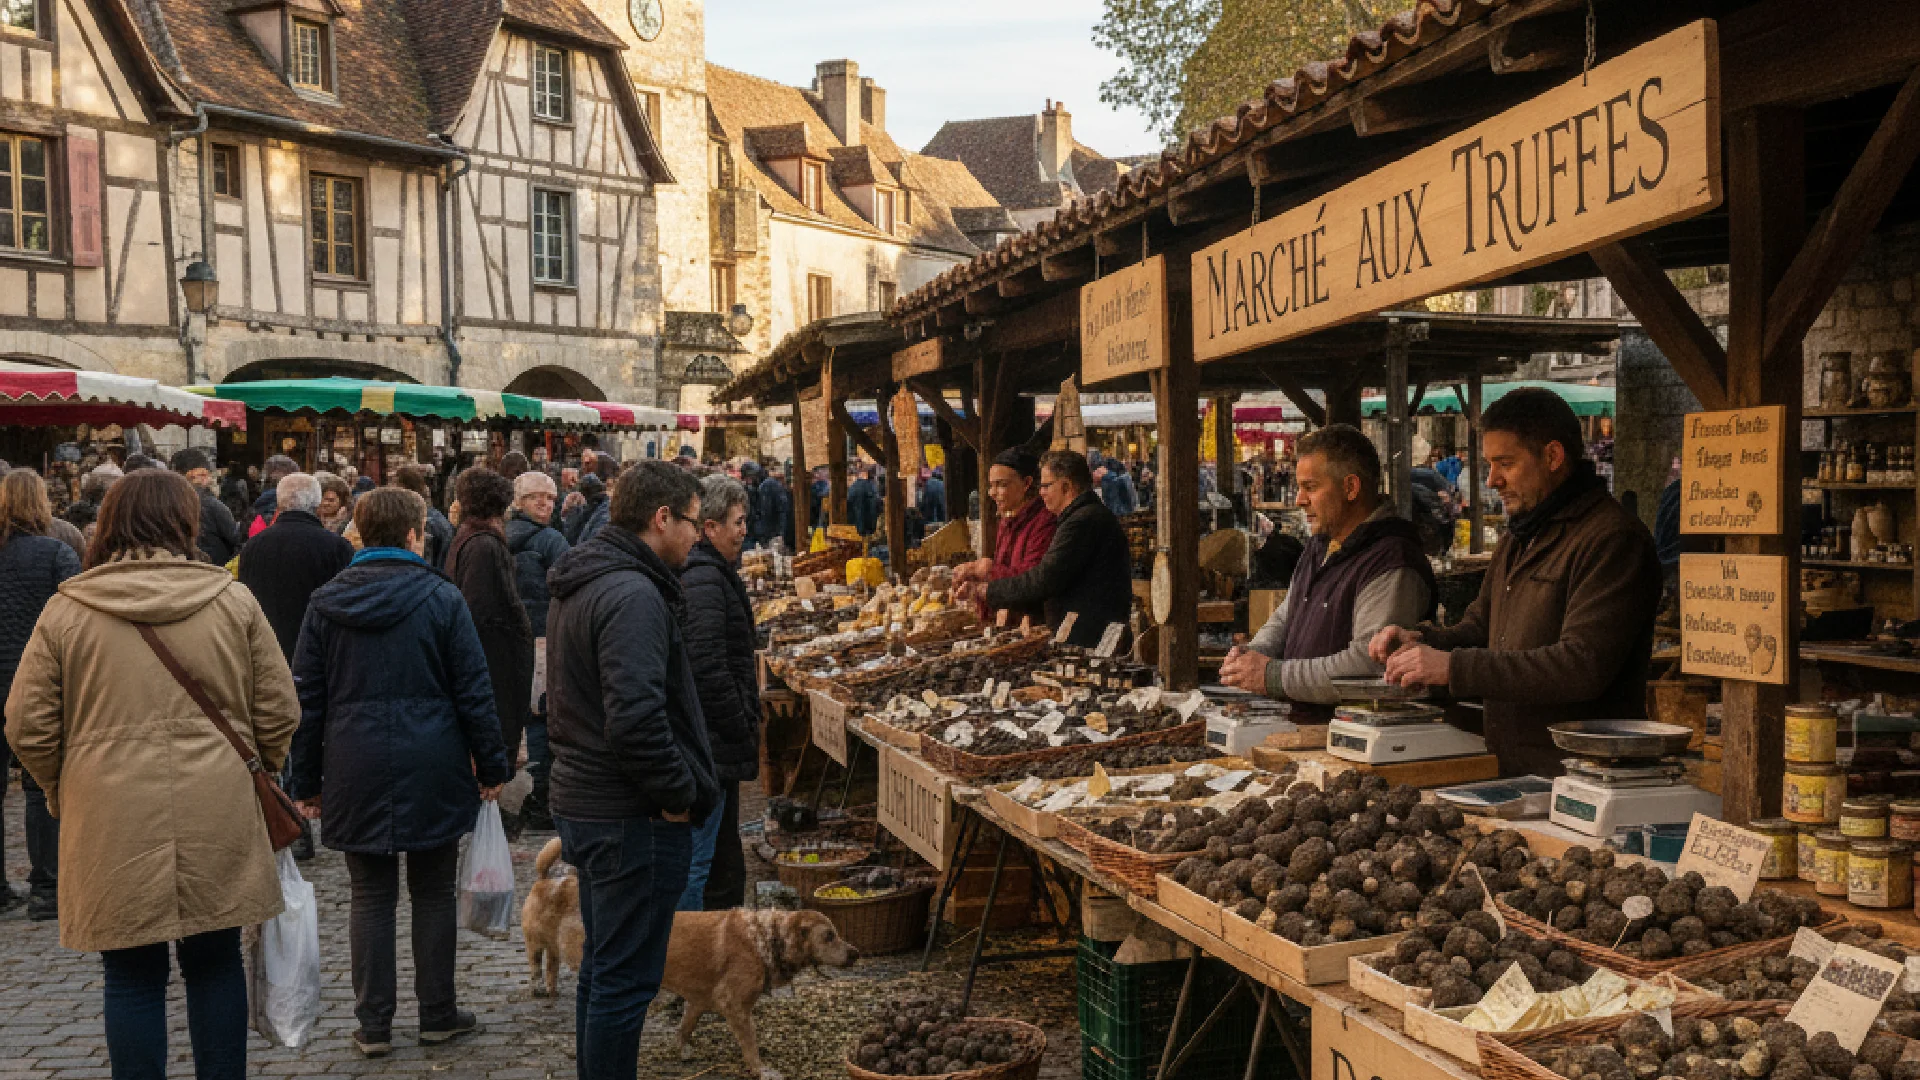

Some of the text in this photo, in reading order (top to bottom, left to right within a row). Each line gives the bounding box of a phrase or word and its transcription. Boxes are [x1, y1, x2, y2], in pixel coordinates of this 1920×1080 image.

[1207, 203, 1331, 340] MARCHÉ
[1355, 181, 1433, 290] AUX
[1452, 77, 1671, 256] TRUFFES
